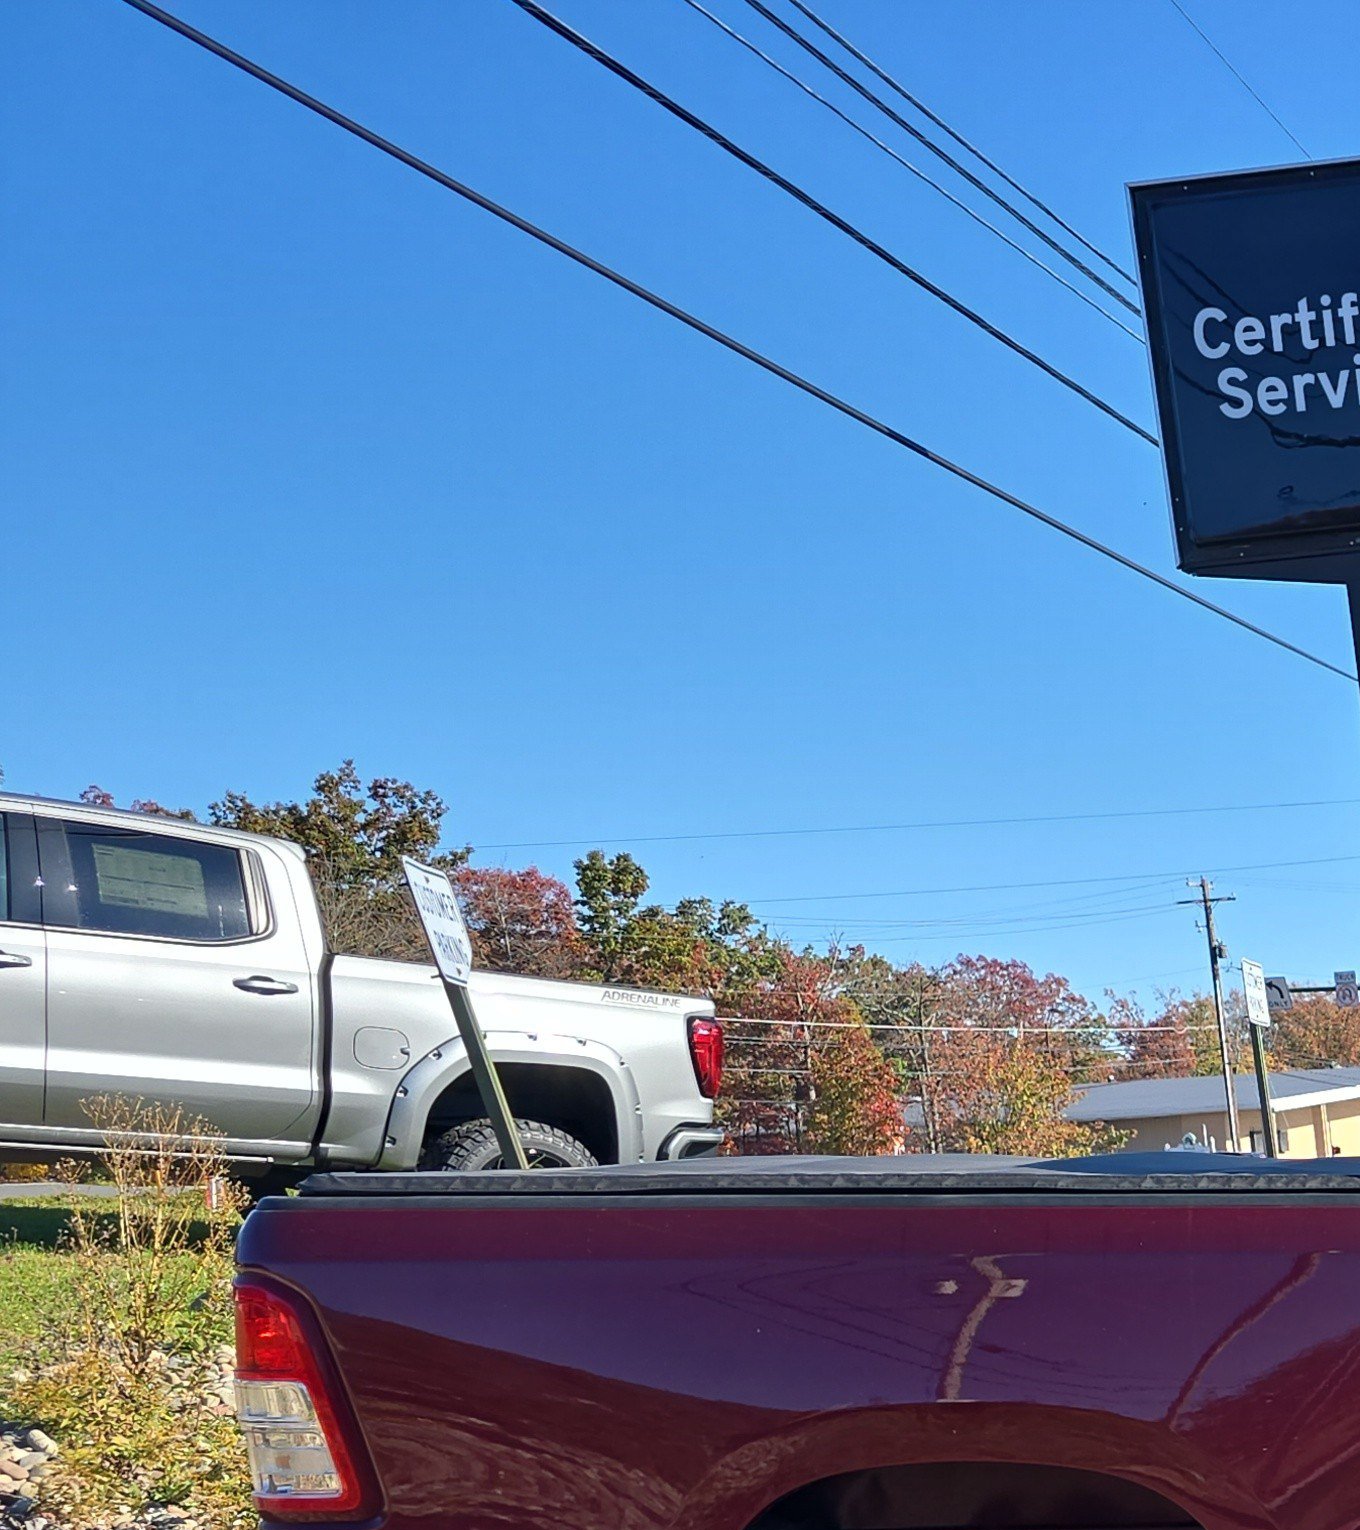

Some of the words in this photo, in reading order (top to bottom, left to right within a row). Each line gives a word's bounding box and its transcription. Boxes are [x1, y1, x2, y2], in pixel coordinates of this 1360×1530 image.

[413, 880, 462, 924] CUSTOMER
[433, 930, 470, 968] PARKING
[601, 990, 681, 1008] ADRENALINE
[1268, 1000, 1288, 1008] ONLY
